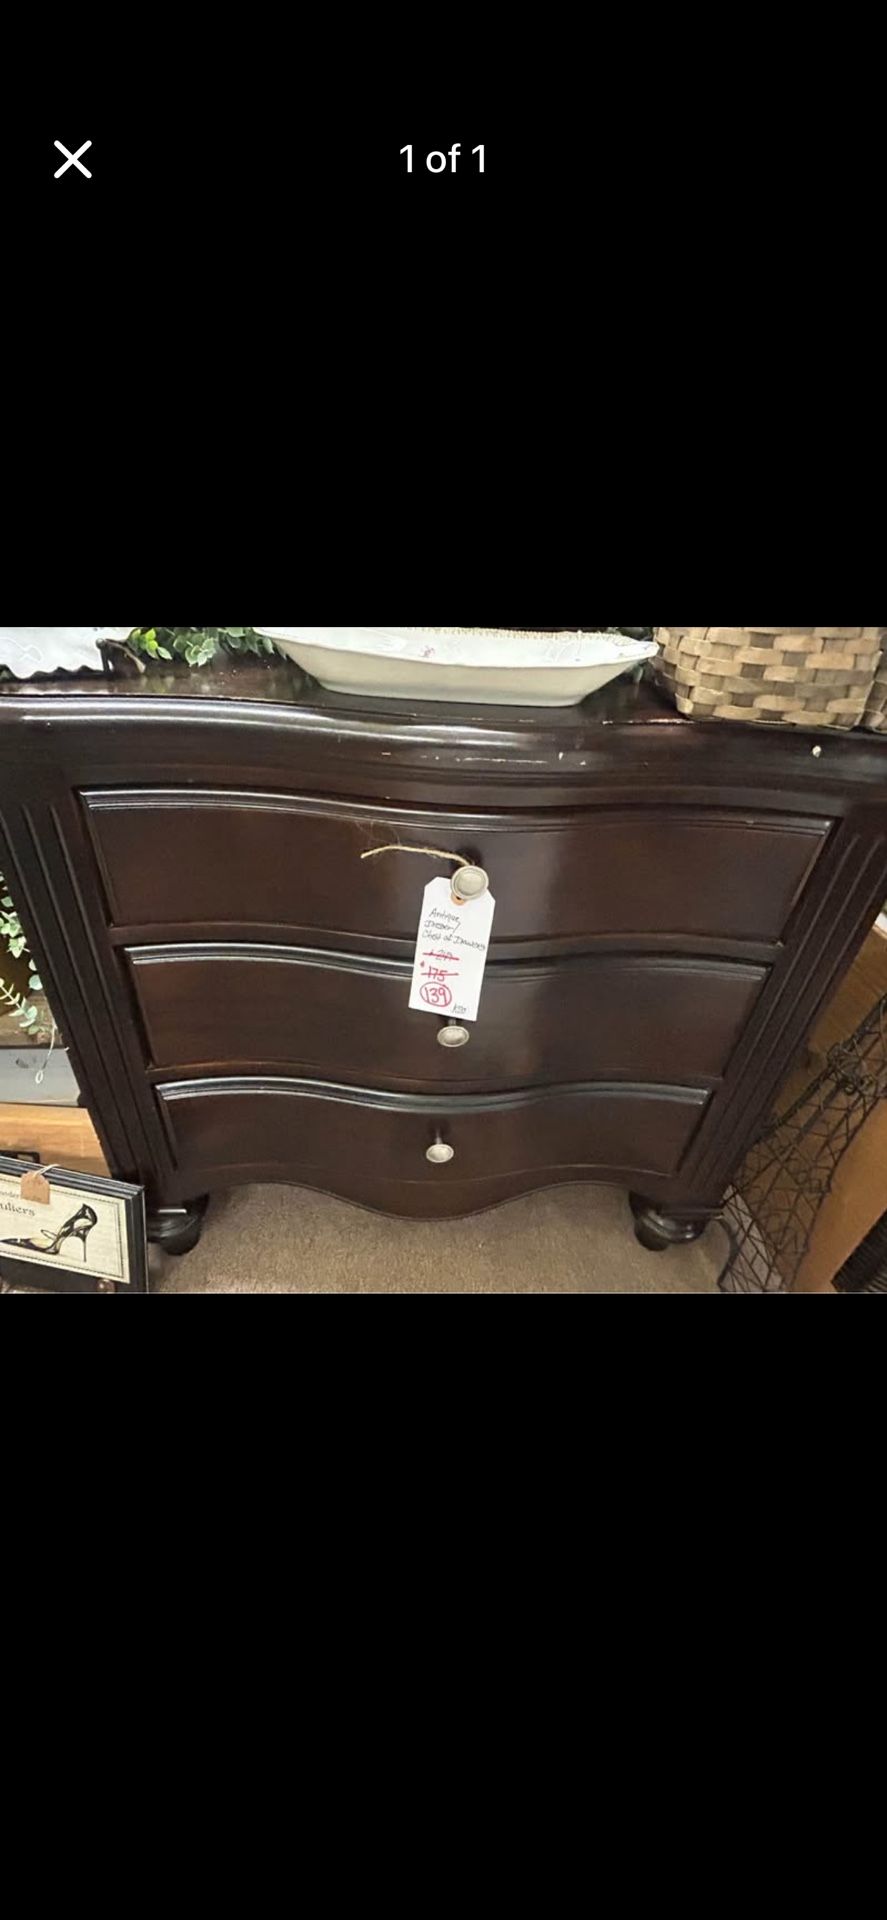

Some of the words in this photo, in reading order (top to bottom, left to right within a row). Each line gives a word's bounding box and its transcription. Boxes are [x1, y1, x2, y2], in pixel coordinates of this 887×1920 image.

[428, 907, 460, 923] Antique
[443, 934, 453, 942] of
[424, 987, 448, 1006] 139
